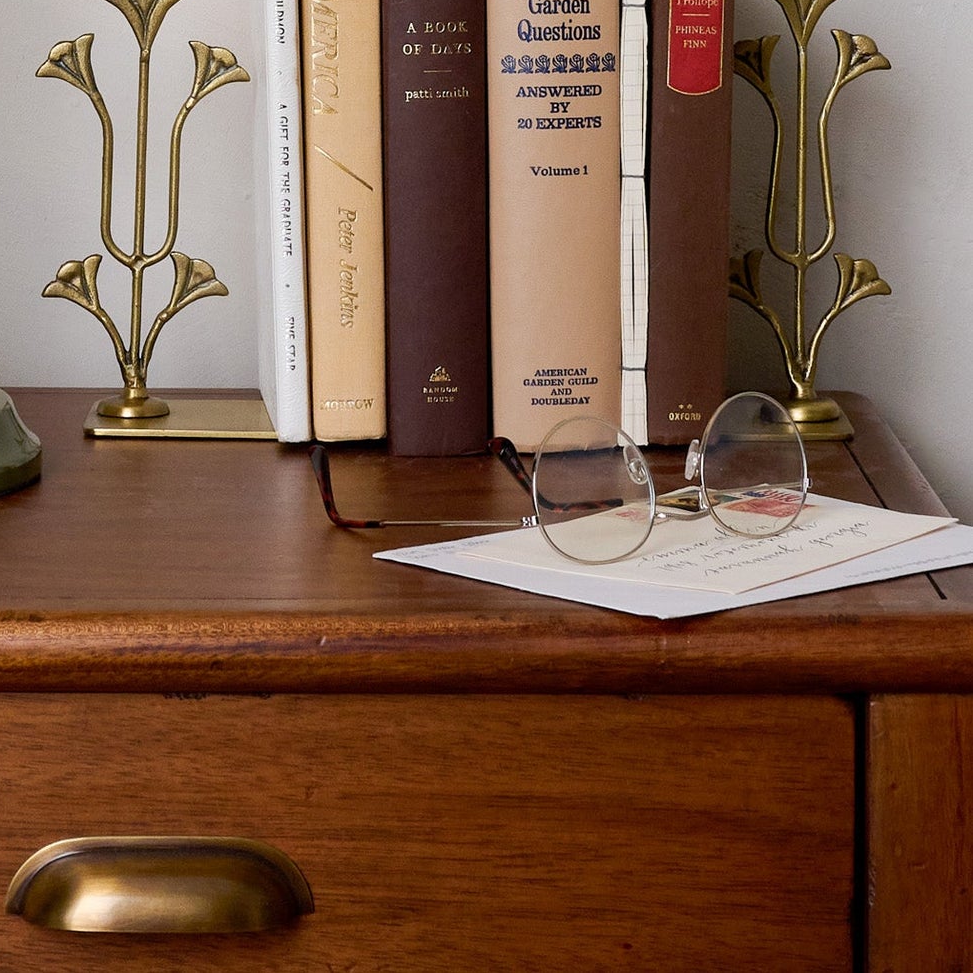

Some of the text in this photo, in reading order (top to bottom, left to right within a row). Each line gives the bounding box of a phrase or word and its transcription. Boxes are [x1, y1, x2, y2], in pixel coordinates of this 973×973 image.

[406, 21, 469, 34] A BOOK
[517, 18, 601, 43] Questions
[675, 25, 717, 35] PHINEAS
[402, 42, 472, 56] OF DAYS
[683, 39, 707, 48] FINN
[405, 86, 469, 103] patti smith
[515, 84, 603, 98] ANSWERED
[550, 102, 571, 113] BY
[517, 116, 602, 129] 20 EXPERTS
[530, 165, 589, 177] Volume 1
[337, 206, 360, 329] Peter Jenkins
[534, 367, 588, 377] AMERICAN
[523, 377, 599, 387] GARDEN GUILD
[422, 386, 458, 394] RANDOM
[551, 388, 572, 396] AND
[531, 397, 591, 406] DOUBLEDAY
[668, 412, 702, 421] OXFORD
